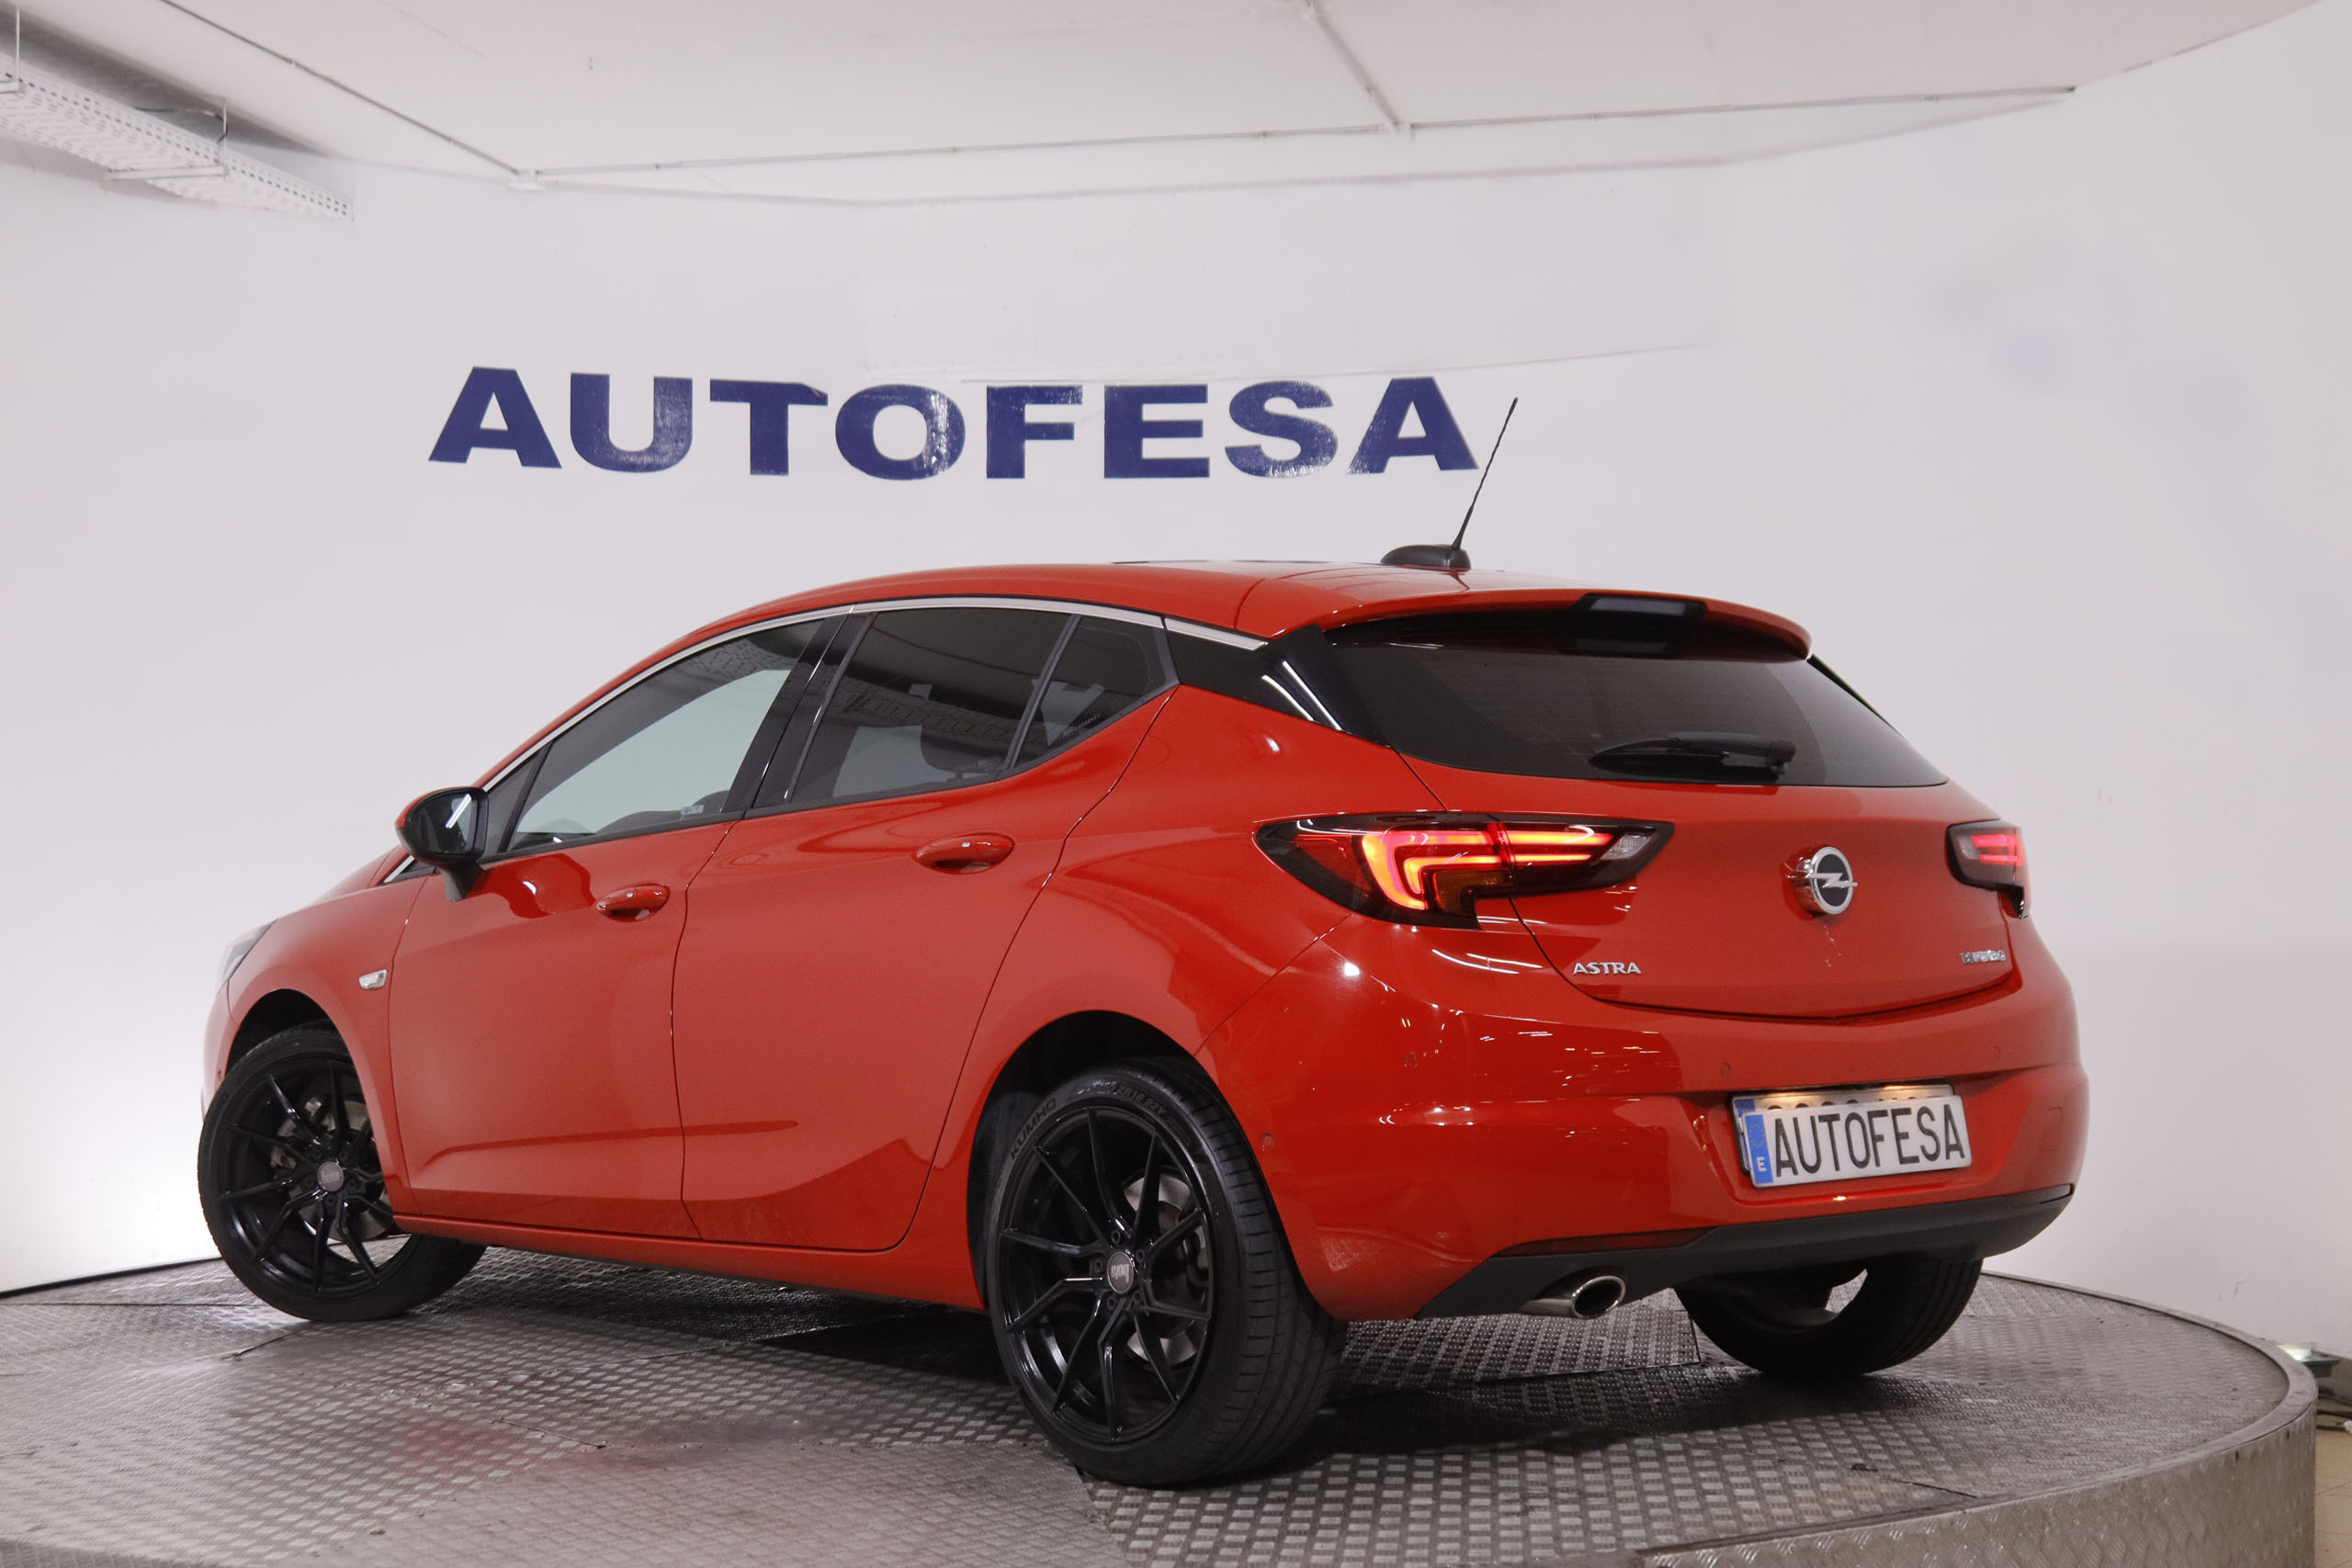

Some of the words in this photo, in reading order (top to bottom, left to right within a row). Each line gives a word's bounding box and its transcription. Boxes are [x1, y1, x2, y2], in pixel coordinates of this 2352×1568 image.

[429, 367, 1480, 480] AUTOFESA
[1572, 962, 1642, 976] ASTRA
[1011, 1097, 1057, 1159] KUMHO
[1775, 1102, 1965, 1178] AUTOFESA
[1756, 1156, 1767, 1172] E
